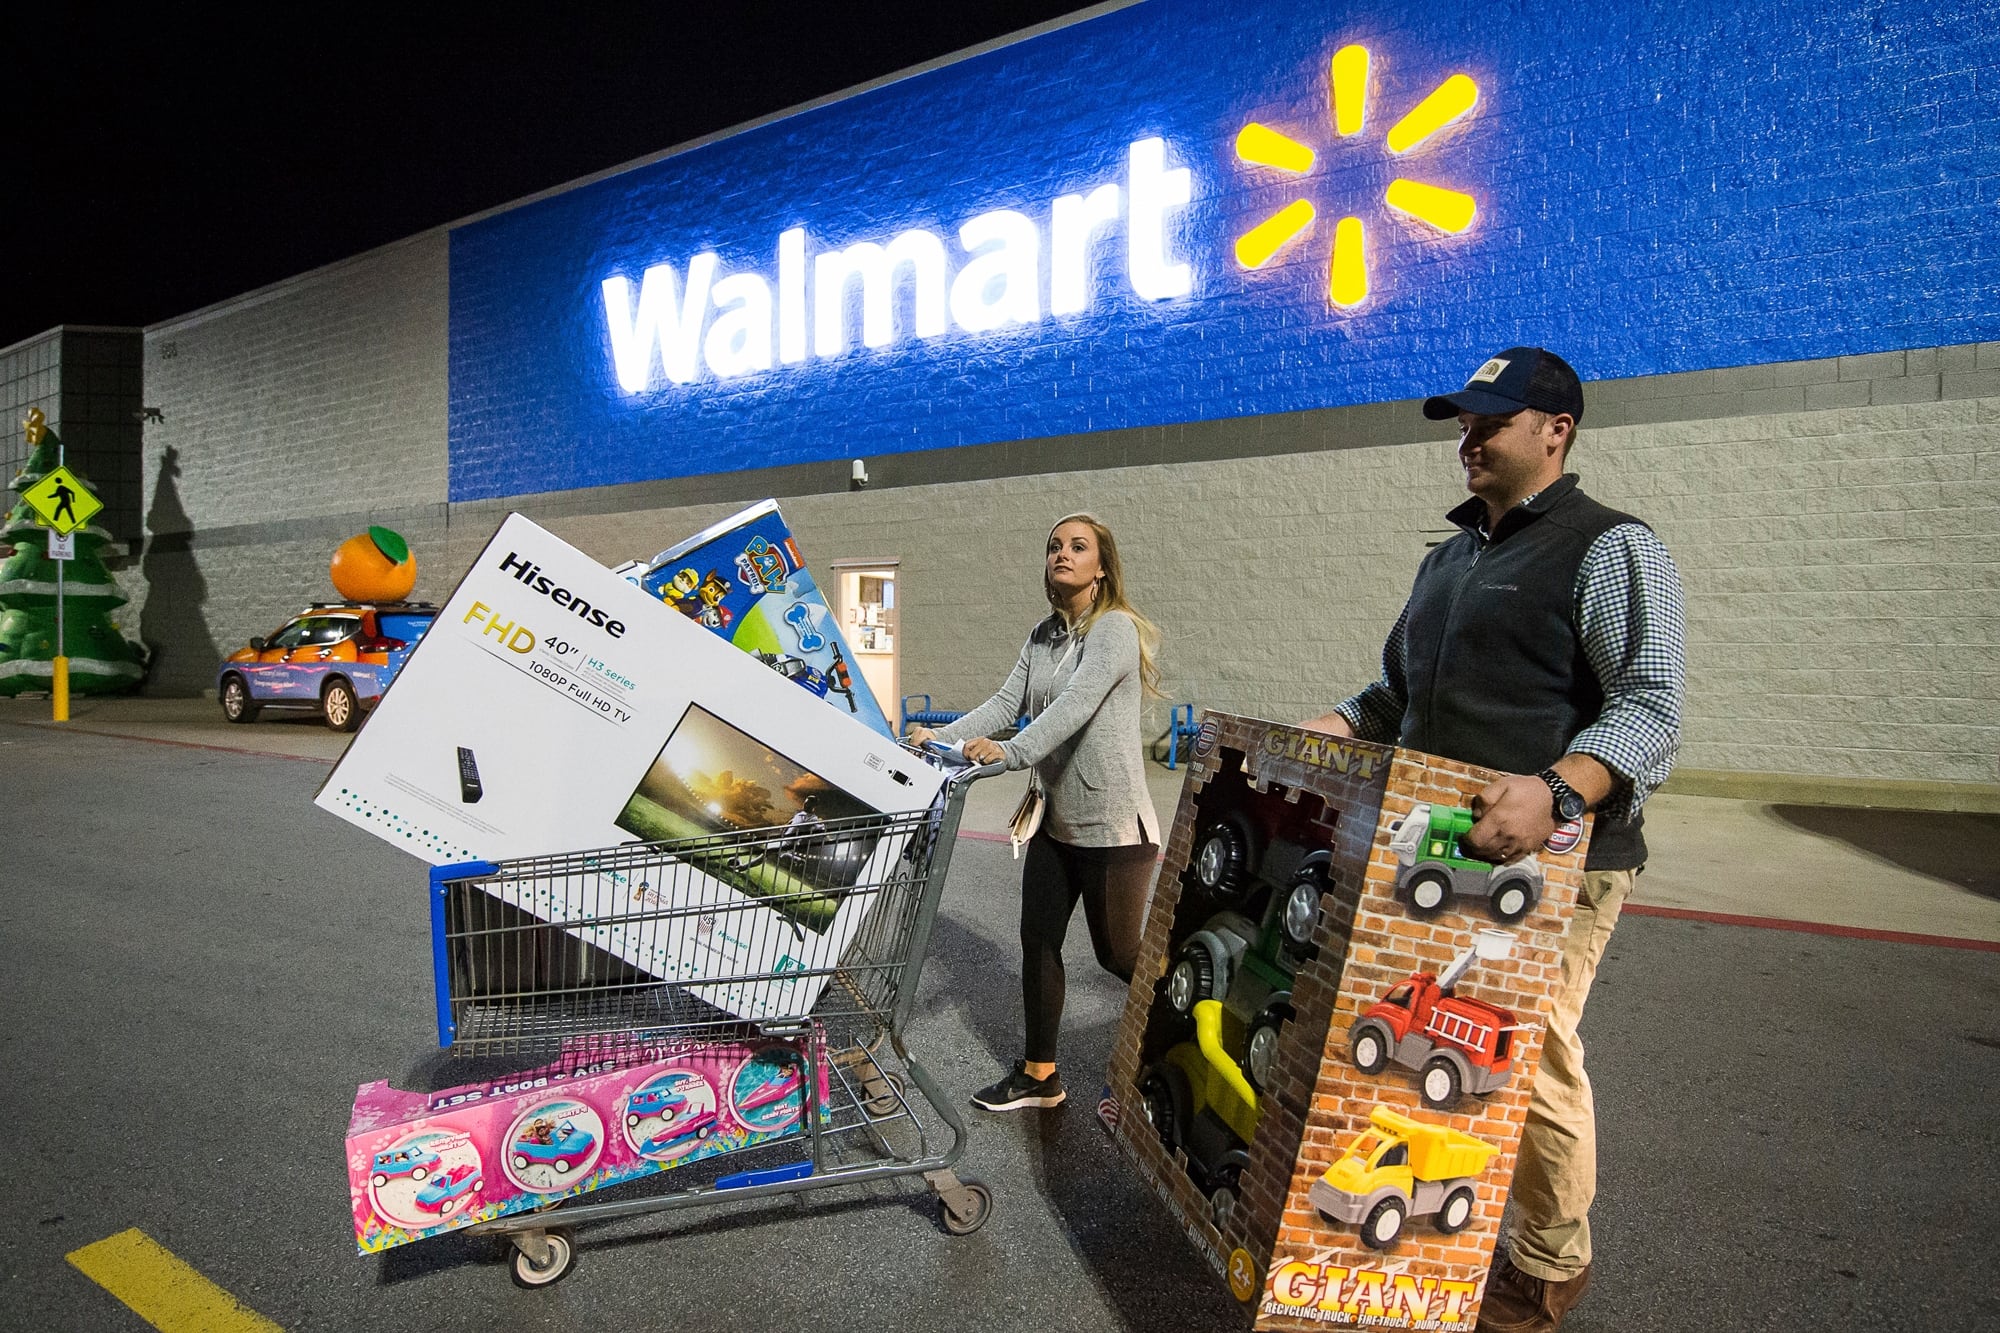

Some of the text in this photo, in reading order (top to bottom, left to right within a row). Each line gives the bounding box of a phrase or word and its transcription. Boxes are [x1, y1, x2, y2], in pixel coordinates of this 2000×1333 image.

[602, 137, 1191, 393] Walmart
[740, 558, 760, 590] PATROL
[745, 535, 786, 594] PAW
[499, 552, 626, 638] Hisense
[463, 601, 536, 654] FHD
[529, 660, 568, 686] 1080P
[568, 683, 592, 702] Full
[592, 697, 611, 712] HD
[614, 708, 631, 723] TV
[587, 658, 605, 672] H3
[604, 669, 637, 691] series
[1263, 729, 1383, 780] GIANT
[489, 1077, 548, 1097] BOAT
[573, 1060, 616, 1078] SUV
[435, 1092, 482, 1109] SET
[1206, 1247, 1228, 1280] TRUCK
[1272, 1260, 1478, 1323] GIANT
[1264, 1302, 1318, 1320] RECYCLING
[1319, 1309, 1352, 1323] TRUCK
[1414, 1320, 1440, 1330] DUMP
[1441, 1321, 1469, 1332] TRUCK
